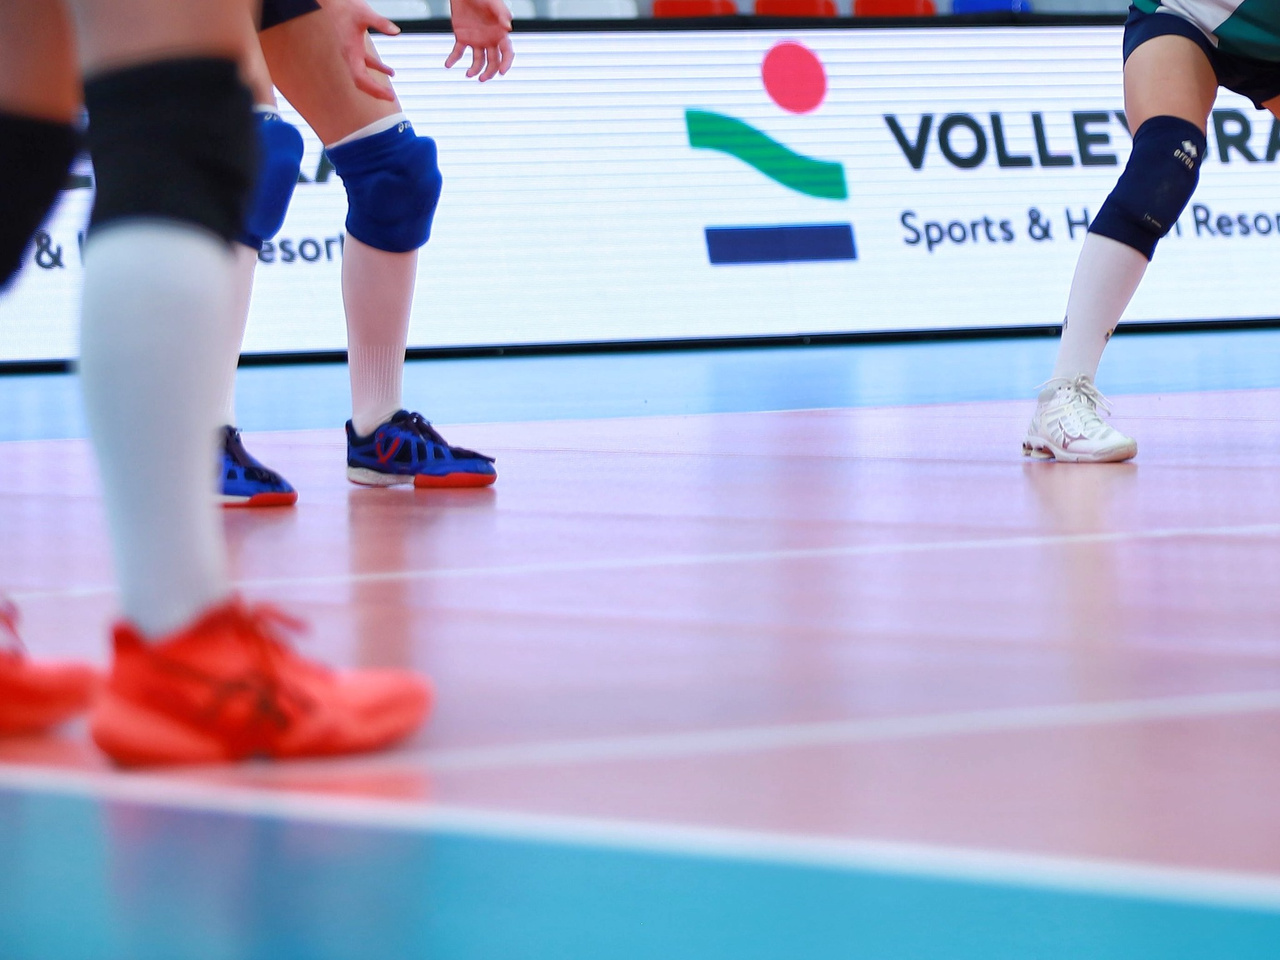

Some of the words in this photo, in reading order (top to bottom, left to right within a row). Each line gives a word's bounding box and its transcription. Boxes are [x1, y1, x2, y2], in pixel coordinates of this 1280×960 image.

[257, 232, 345, 263] esor
[900, 209, 1015, 253] Sports
[1028, 206, 1053, 241] &
